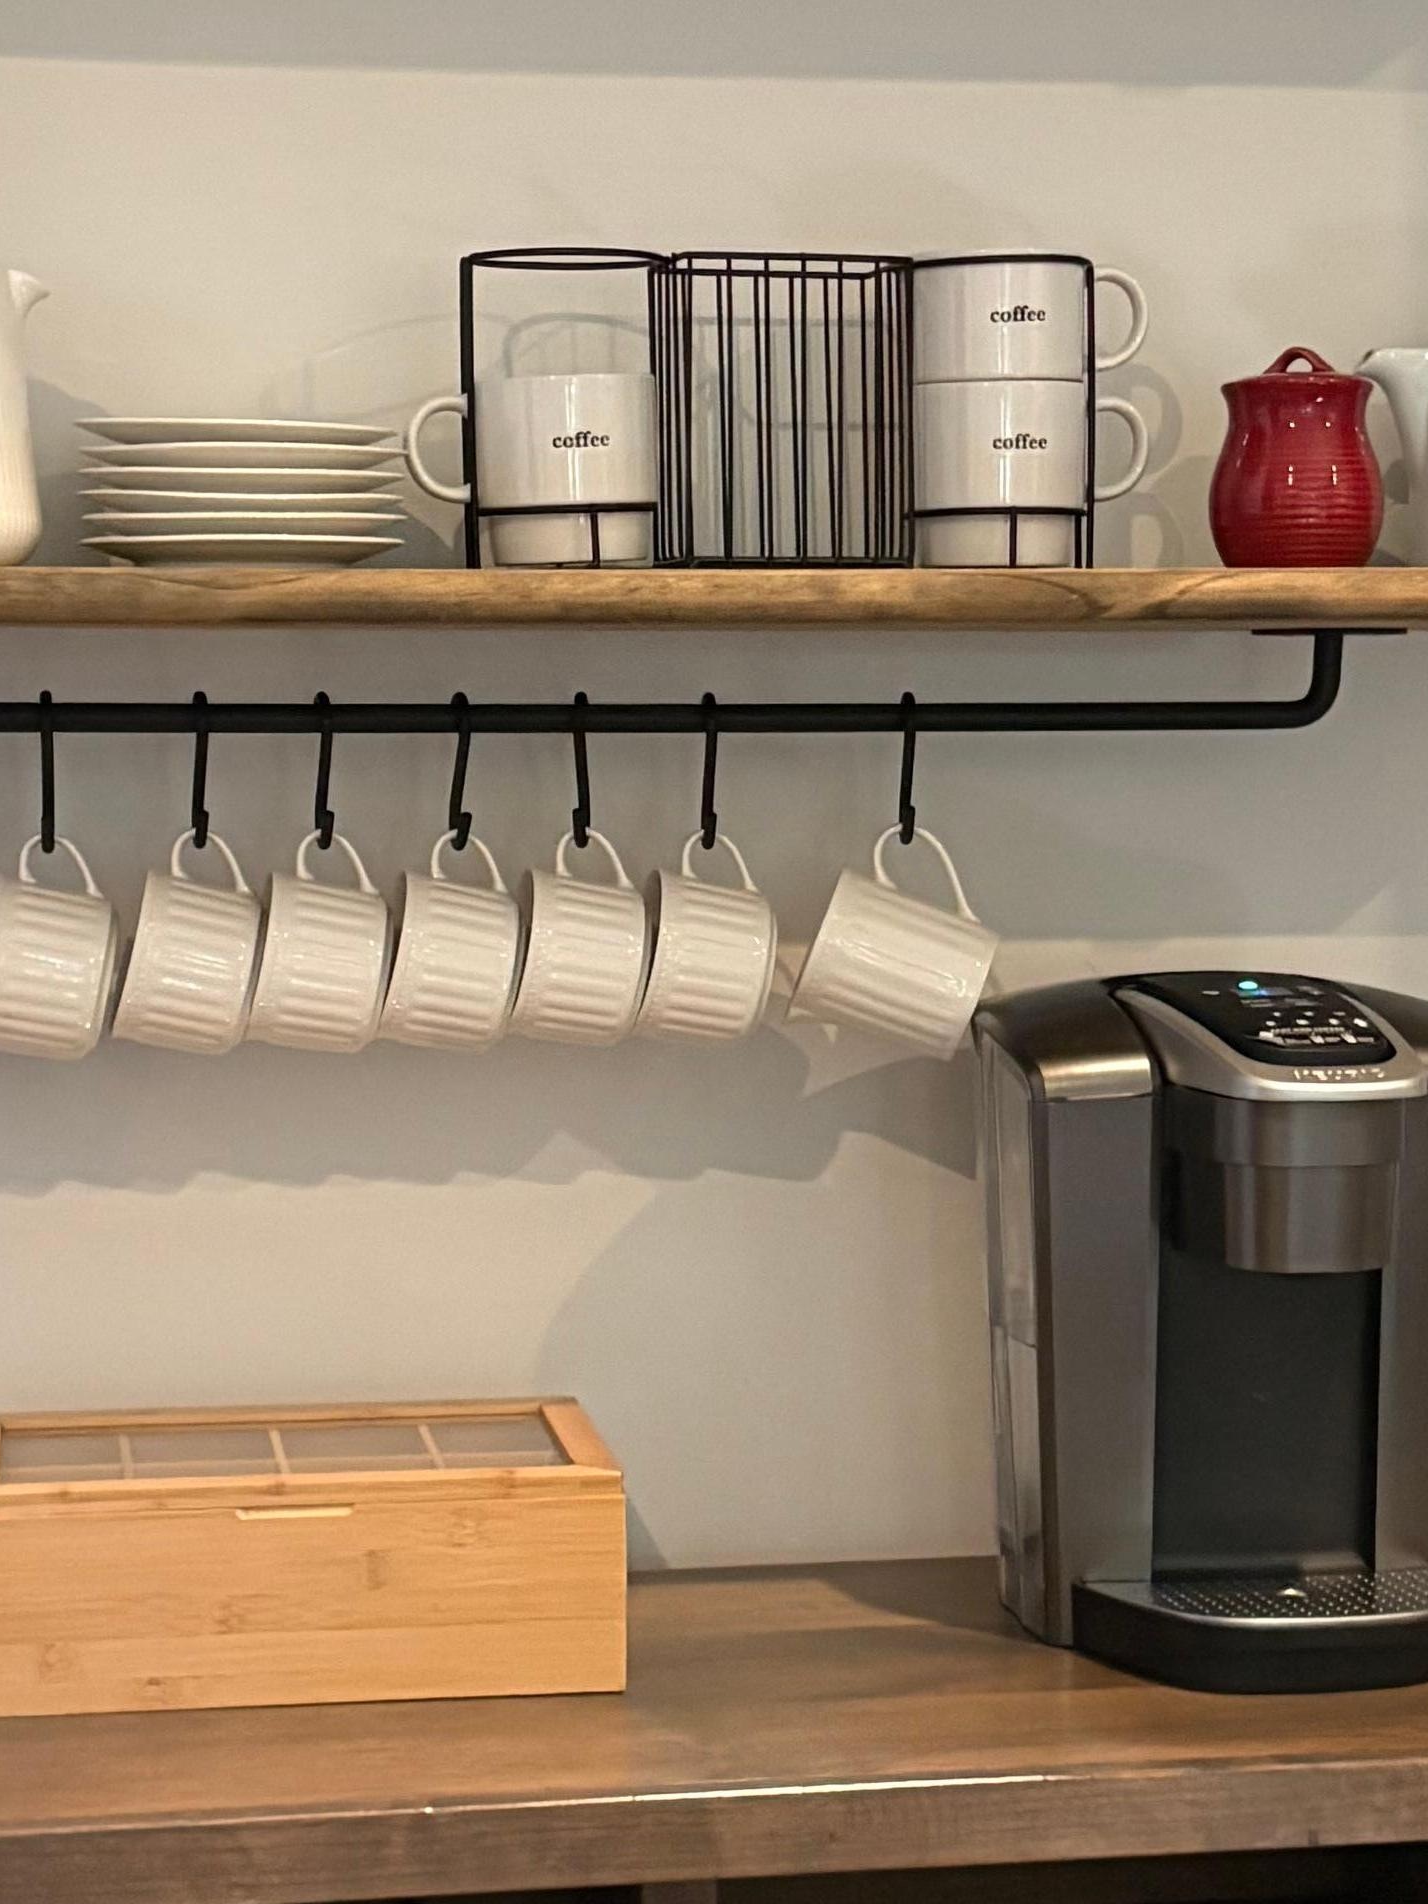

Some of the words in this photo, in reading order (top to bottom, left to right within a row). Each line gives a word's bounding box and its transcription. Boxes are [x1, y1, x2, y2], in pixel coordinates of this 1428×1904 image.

[990, 305, 1046, 324] coffee
[552, 430, 610, 449] coffee
[992, 433, 1048, 450] coffee
